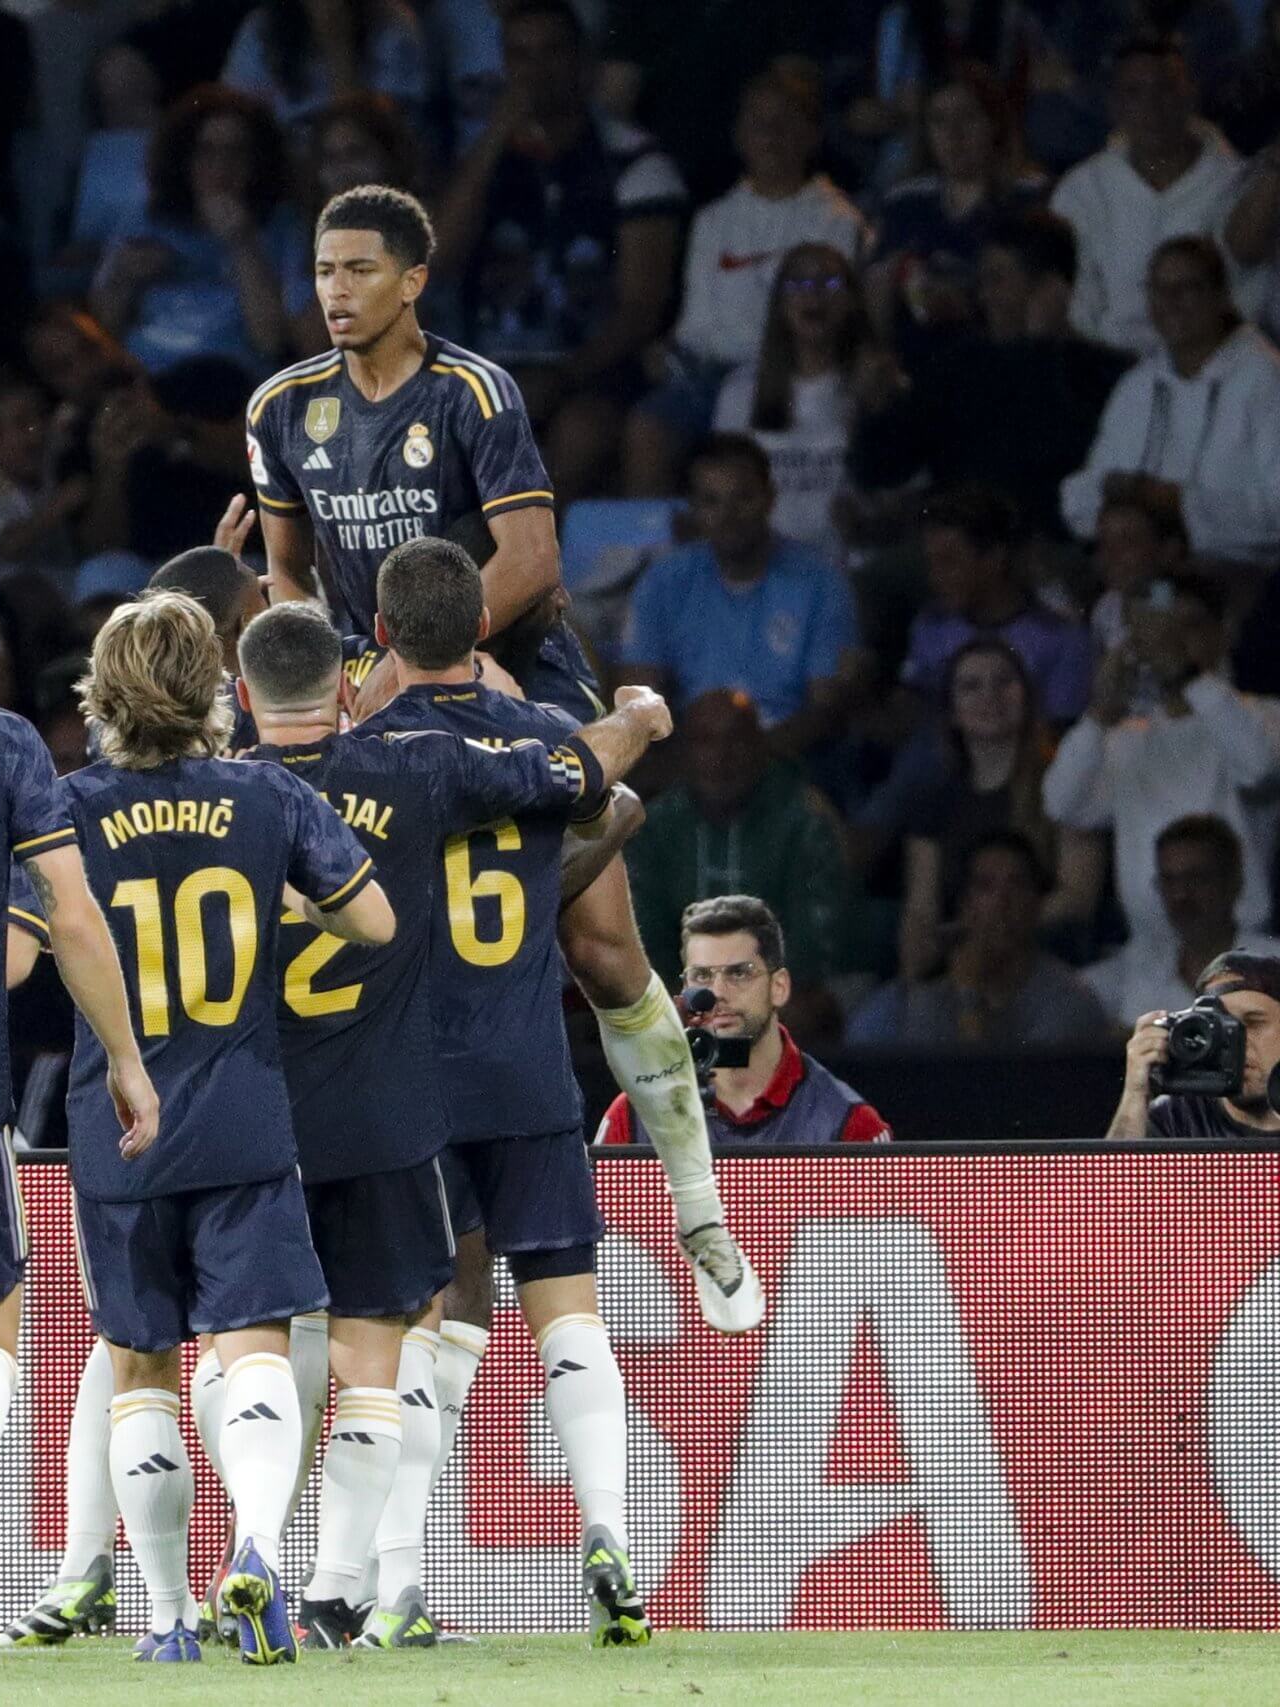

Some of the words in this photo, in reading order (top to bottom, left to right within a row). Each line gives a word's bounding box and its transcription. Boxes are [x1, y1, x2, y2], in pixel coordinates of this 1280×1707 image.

[310, 485, 438, 520] Emirates
[337, 524, 361, 550] FLY
[364, 517, 425, 550] BETTER
[444, 817, 525, 967] 6
[111, 867, 257, 1036] 10
[280, 910, 363, 1017] 2
